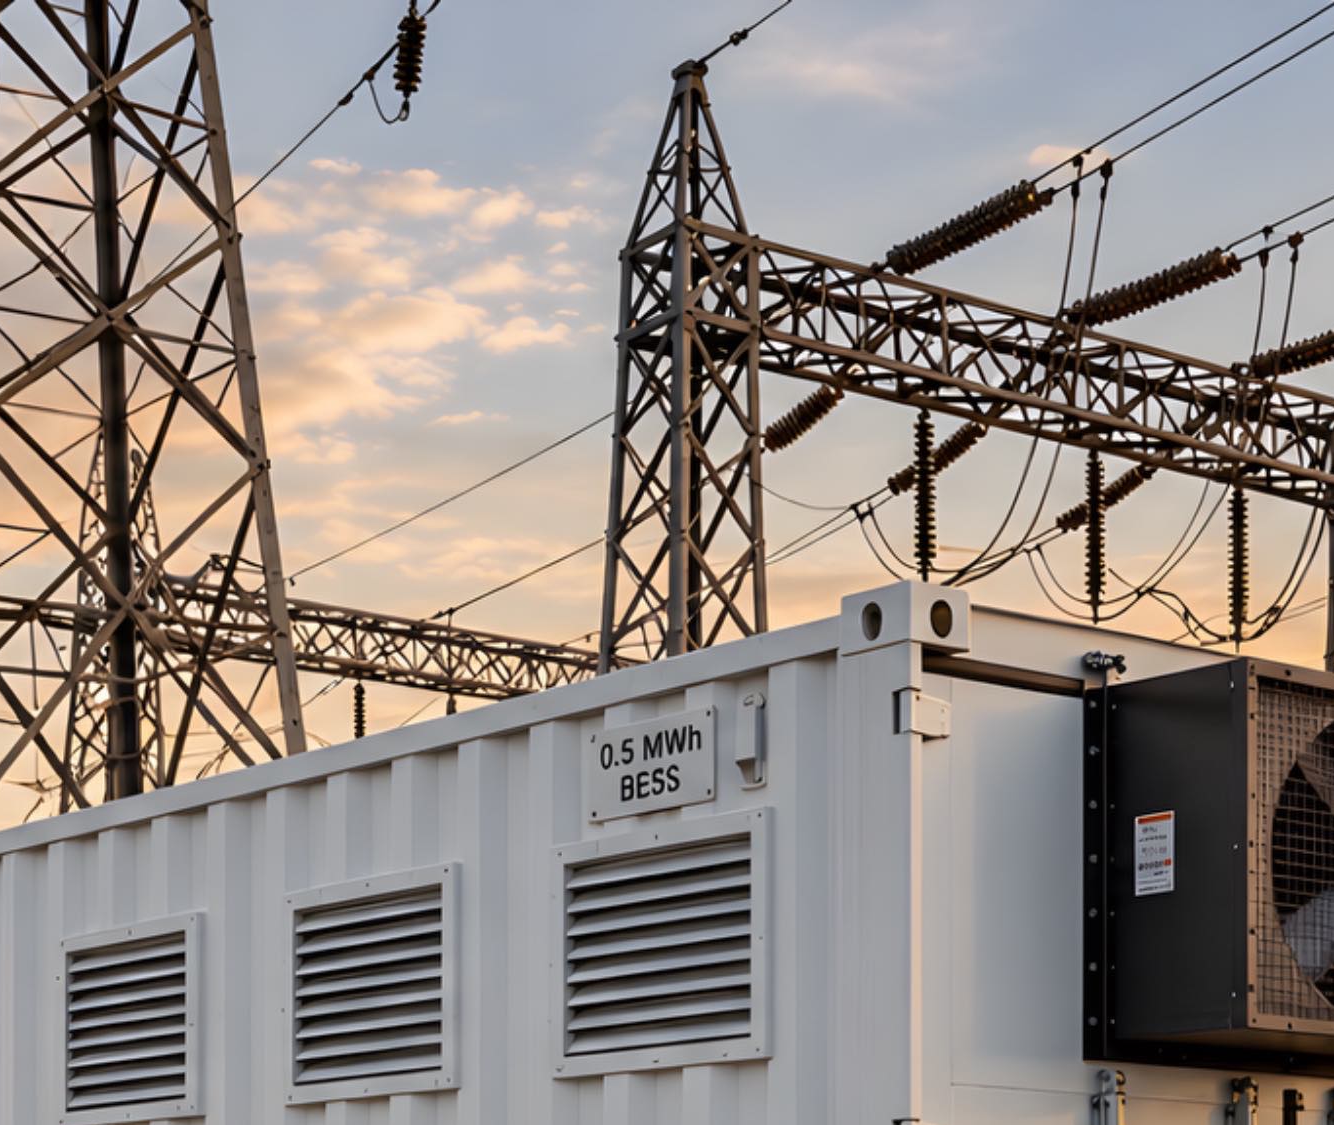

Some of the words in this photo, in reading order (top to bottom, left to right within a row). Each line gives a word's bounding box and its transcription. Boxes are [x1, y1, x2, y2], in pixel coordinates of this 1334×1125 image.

[600, 738, 634, 770] 0.5
[643, 725, 702, 761] MWh
[620, 765, 681, 802] BESS
